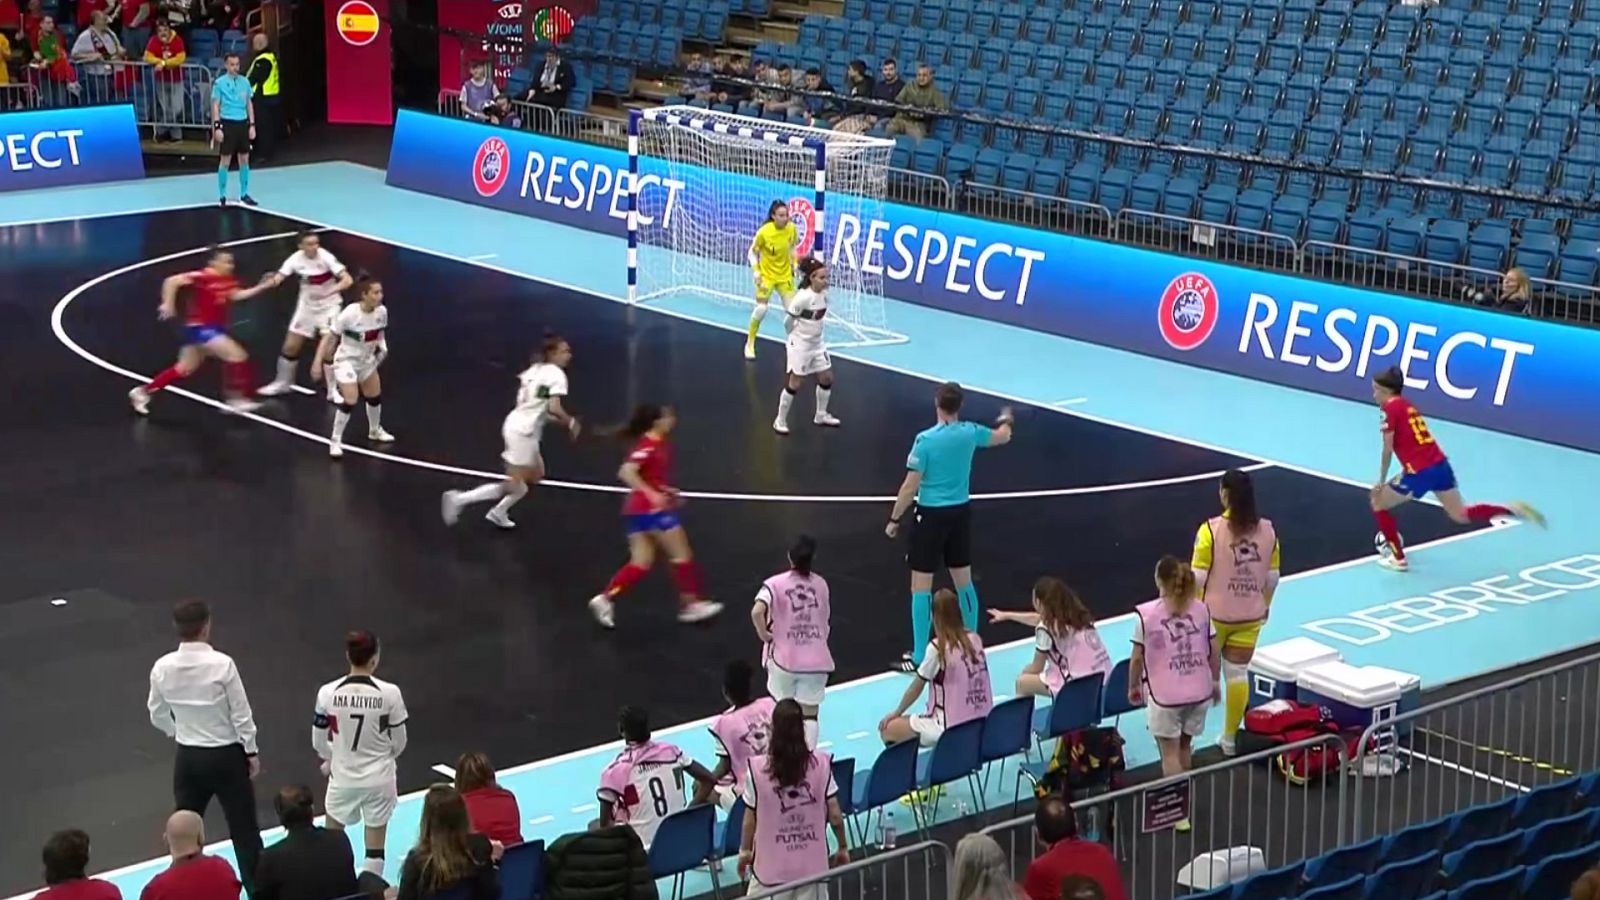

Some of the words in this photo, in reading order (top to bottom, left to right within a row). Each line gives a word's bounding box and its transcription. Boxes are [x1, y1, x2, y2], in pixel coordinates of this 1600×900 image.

[0, 129, 84, 171] ECT
[520, 150, 686, 230] RESPECT
[831, 212, 1046, 306] RESPECT
[1174, 276, 1210, 299] UEFA
[1237, 292, 1536, 407] RESPECT
[1300, 553, 1600, 646] DEBRECE
[333, 695, 348, 708] ANA
[350, 695, 383, 710] AZEVEDO
[349, 713, 365, 752] 7
[649, 776, 668, 818] 8
[775, 831, 820, 844] FUTSAL
